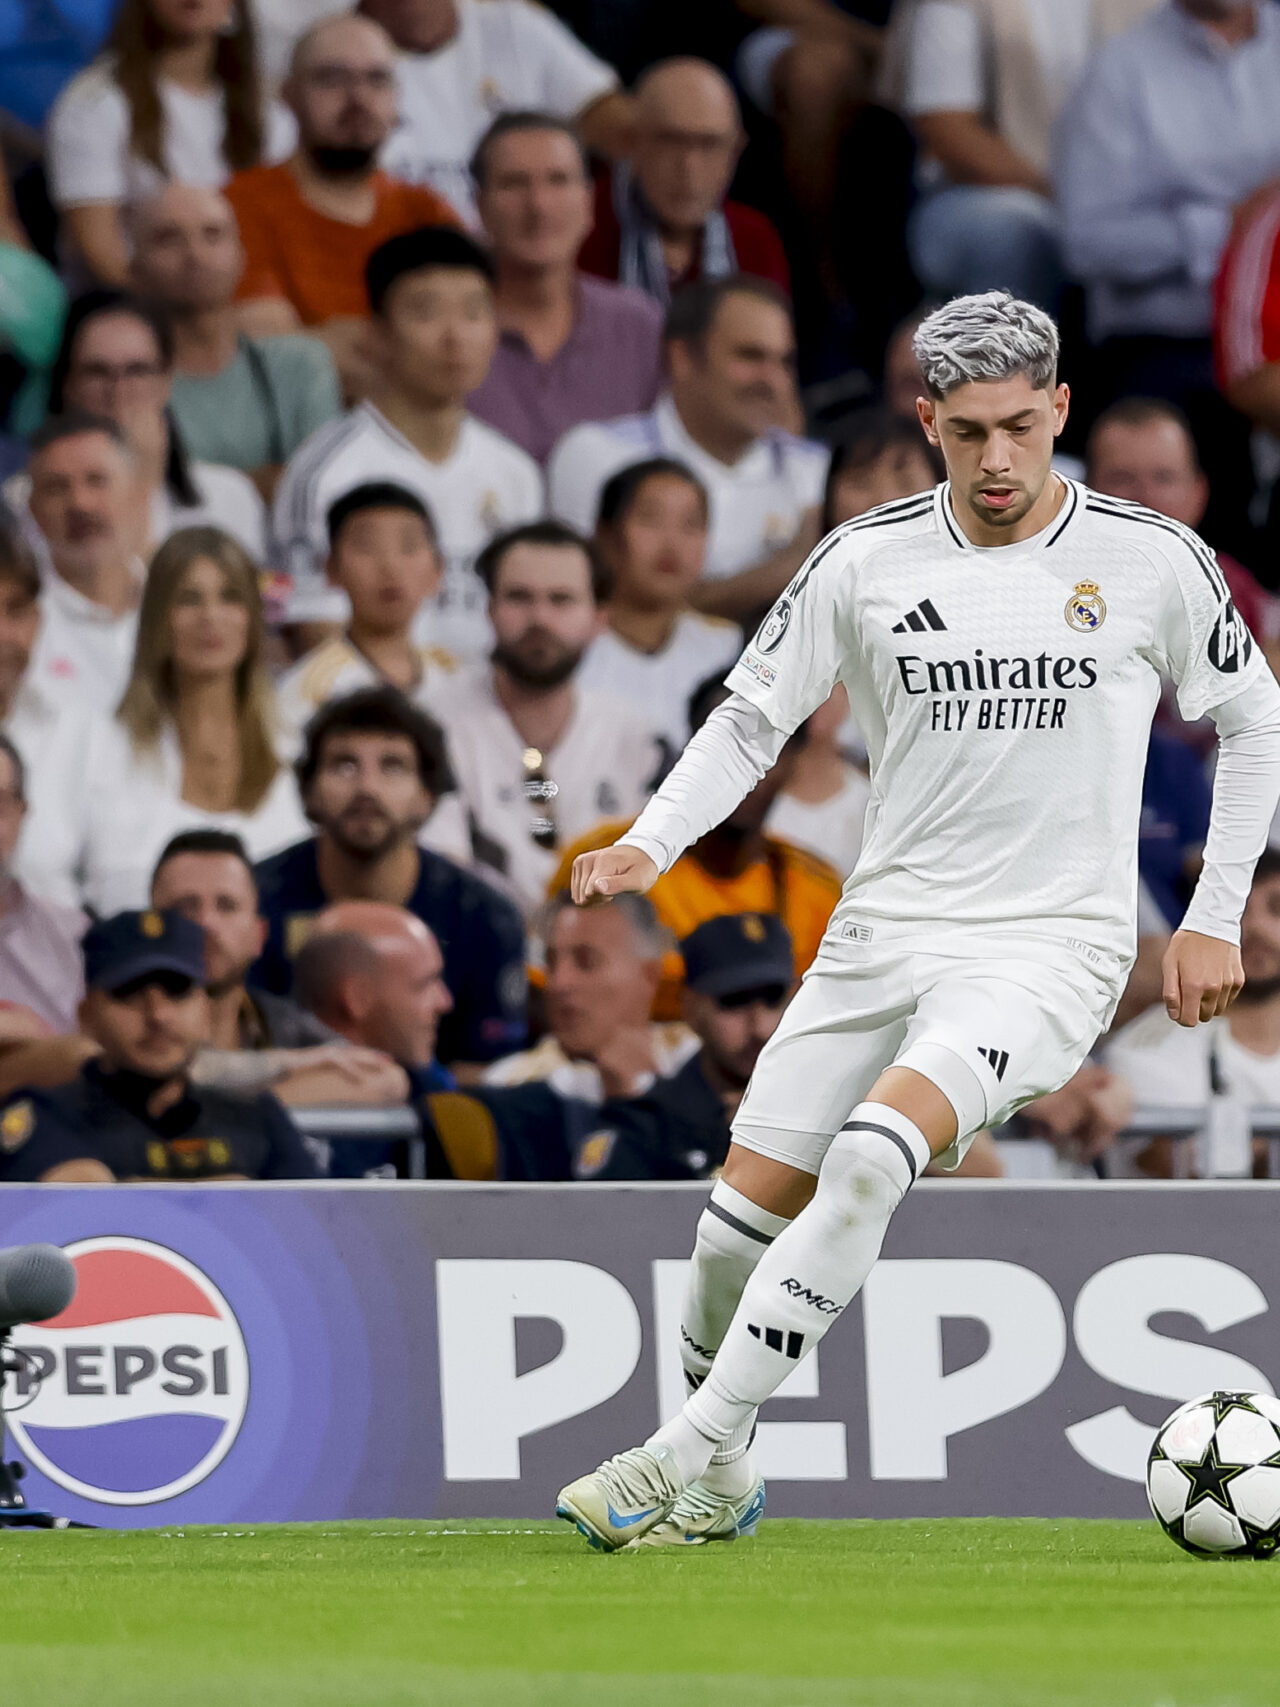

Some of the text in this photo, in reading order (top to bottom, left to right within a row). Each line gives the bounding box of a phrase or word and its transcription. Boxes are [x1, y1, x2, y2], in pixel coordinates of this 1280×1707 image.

[895, 648, 1097, 694] Emirates
[932, 698, 1068, 731] FLY BETTER
[14, 1344, 230, 1396] PEPSI
